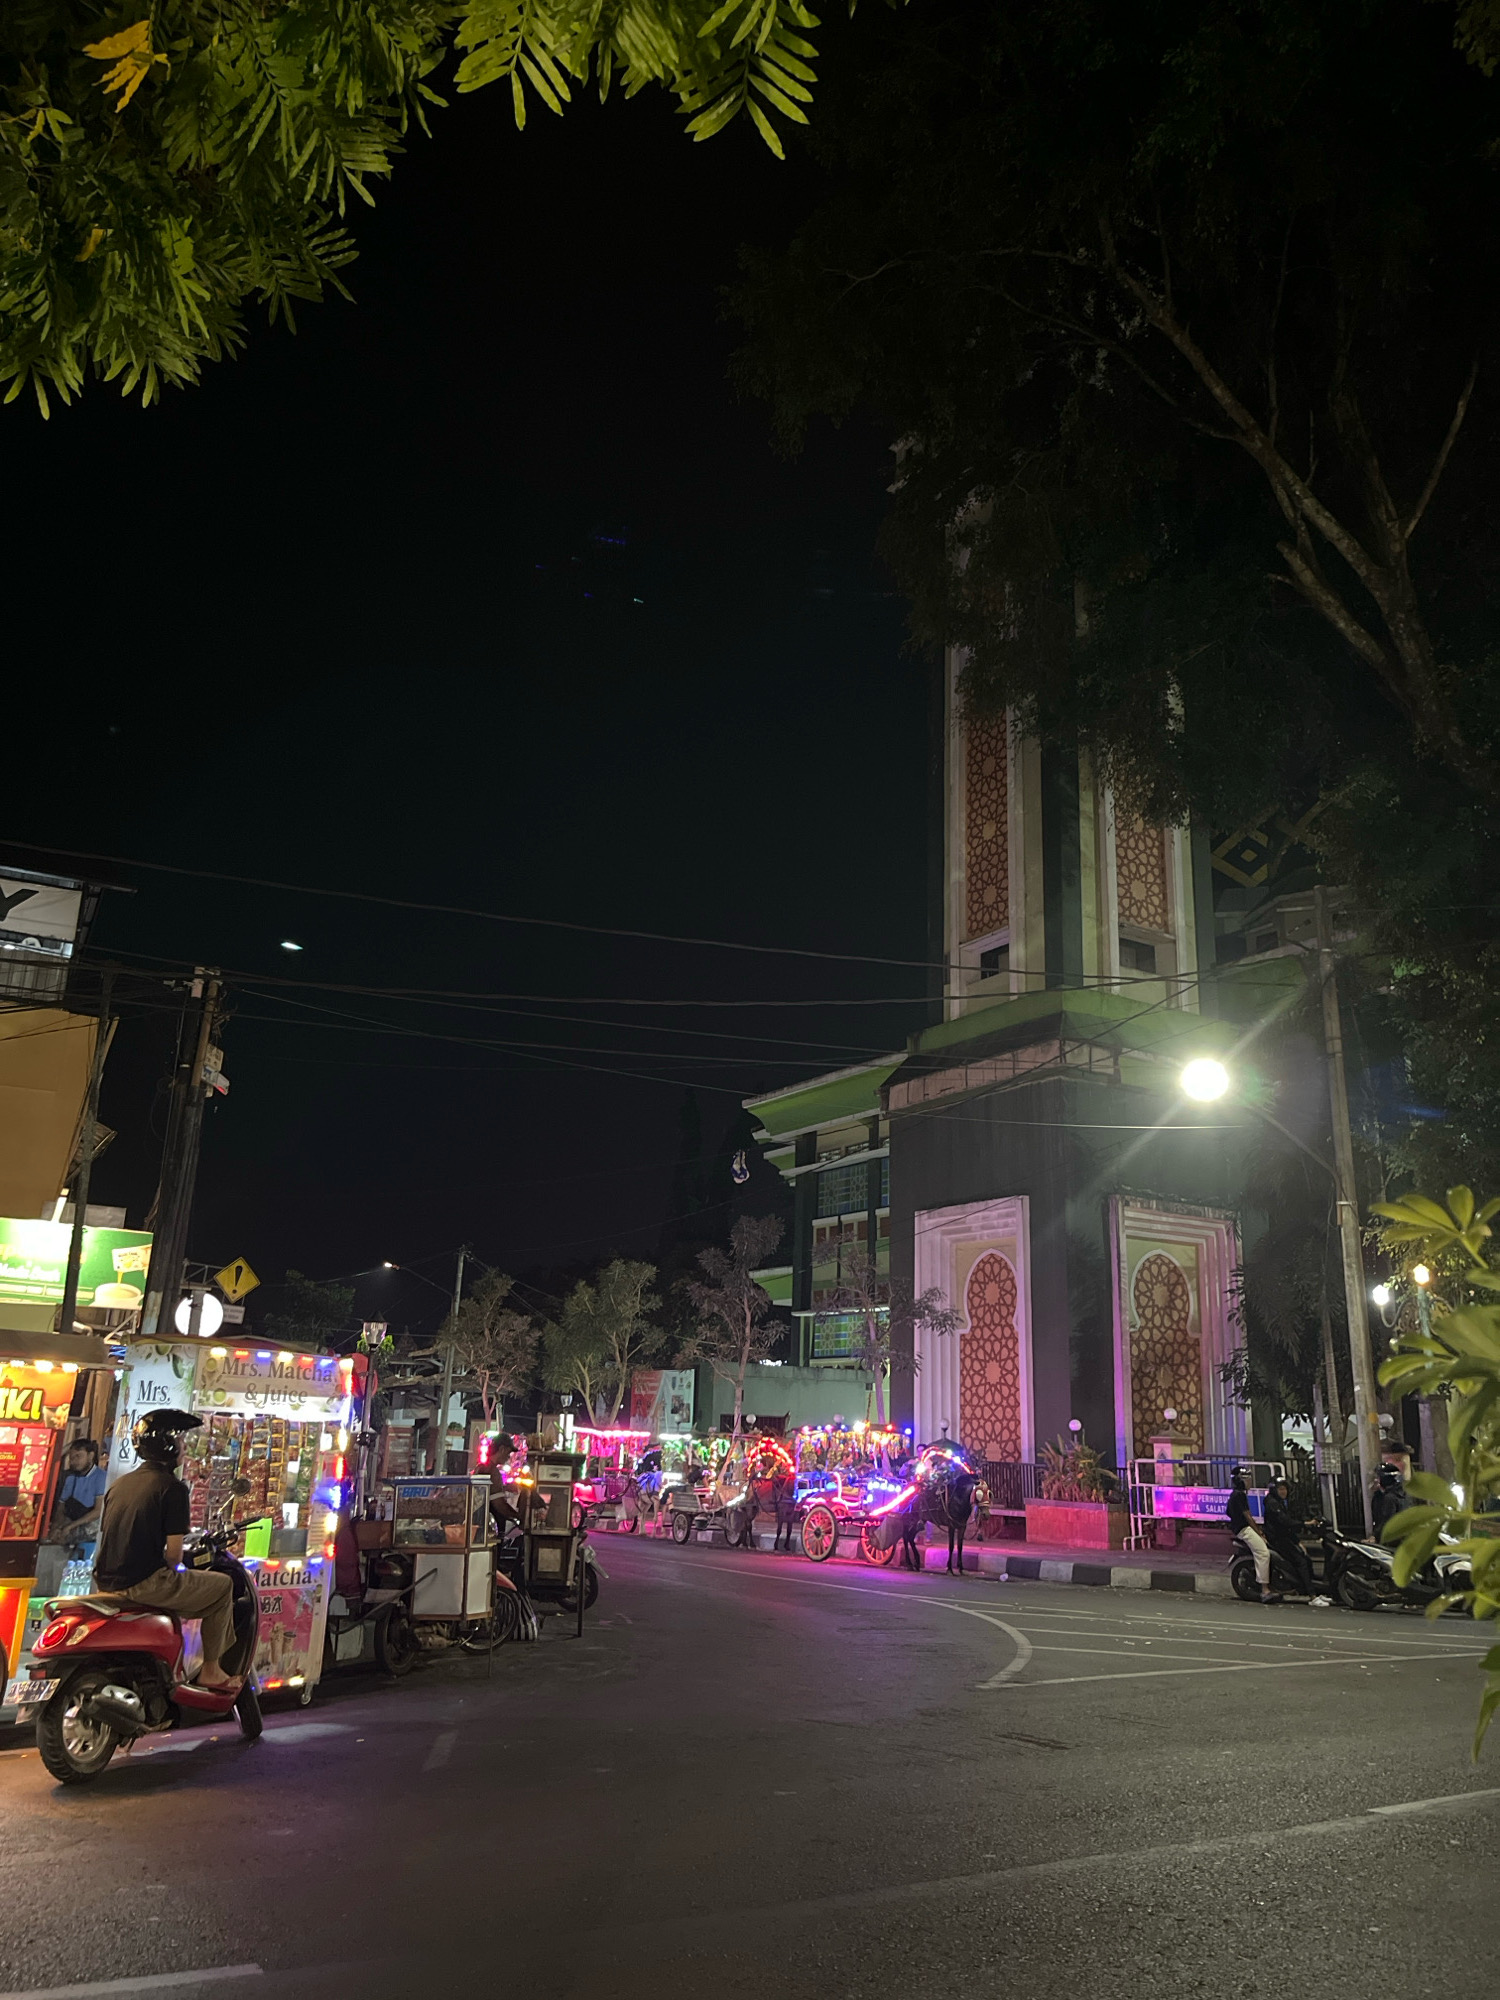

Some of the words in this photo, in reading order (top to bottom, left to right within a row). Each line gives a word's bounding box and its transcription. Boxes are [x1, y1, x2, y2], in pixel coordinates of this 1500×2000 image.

[222, 1357, 262, 1377] Mrs.
[267, 1361, 333, 1383] Matcha
[137, 1380, 171, 1402] Mrs.
[245, 1383, 258, 1401] &
[263, 1384, 308, 1405] Juice
[1173, 1493, 1193, 1502] DINAS
